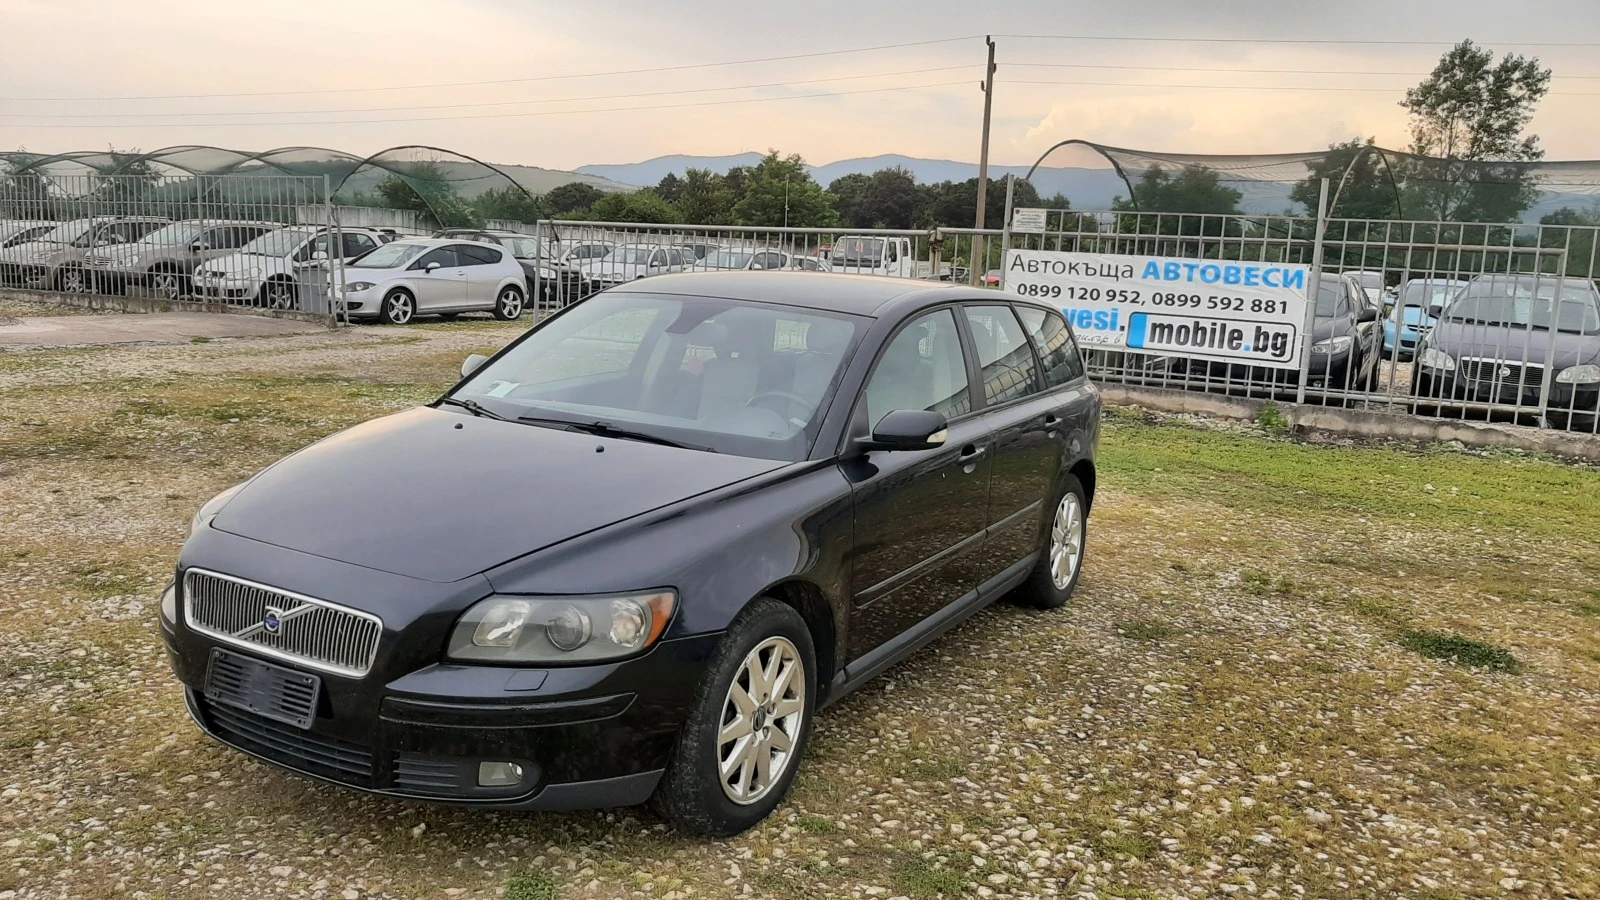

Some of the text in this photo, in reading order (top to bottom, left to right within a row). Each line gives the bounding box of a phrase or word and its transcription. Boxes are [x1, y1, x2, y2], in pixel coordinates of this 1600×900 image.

[1010, 254, 1305, 290] Автокъща АВТОВЕСИ
[1017, 283, 1287, 314] 0899 120 952, 0899 592 881
[1149, 321, 1288, 358] mobile.bg
